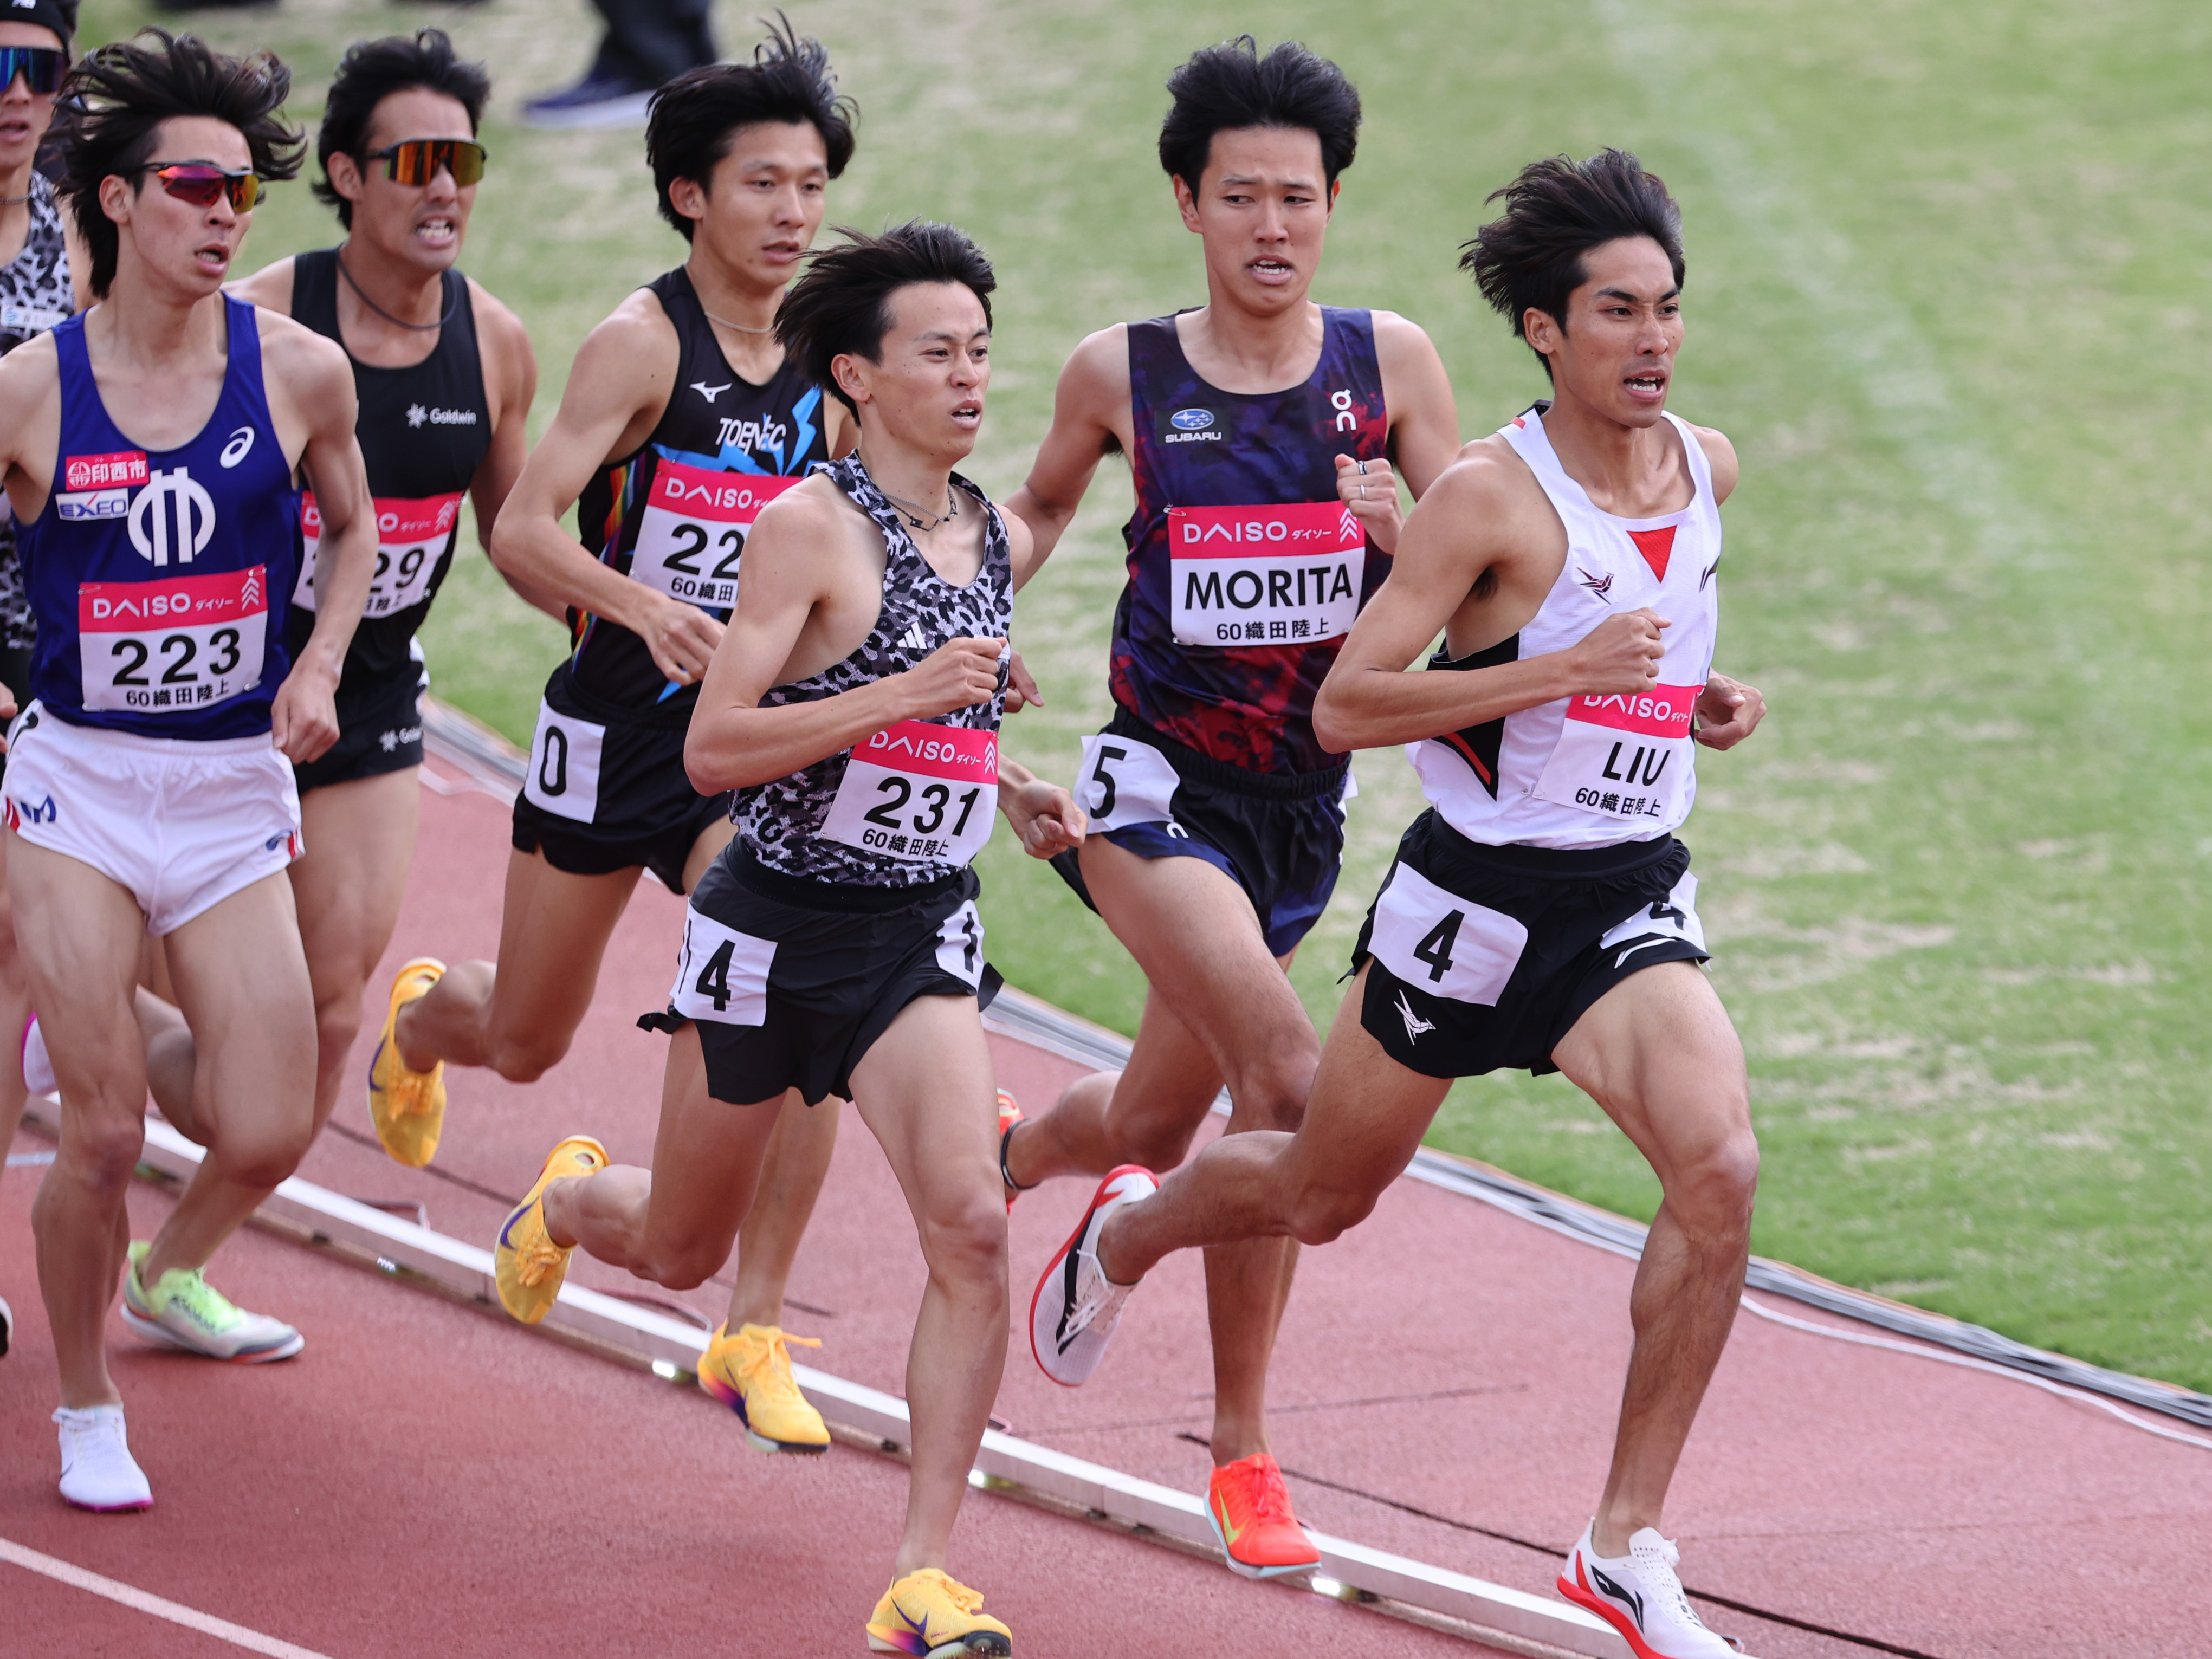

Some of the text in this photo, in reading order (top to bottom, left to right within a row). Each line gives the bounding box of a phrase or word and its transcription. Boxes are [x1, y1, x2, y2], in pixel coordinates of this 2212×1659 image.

[430, 407, 476, 425] Goldwin
[715, 414, 787, 457] TOENEC
[1165, 432, 1221, 443] SUBARU
[91, 459, 146, 484] 印西市
[59, 492, 126, 517] EXEO
[664, 477, 753, 509] DAISO
[1183, 521, 1332, 543] DAISO ダイソー
[663, 523, 745, 579] 22
[306, 549, 424, 592] 29
[671, 576, 738, 601] 60織田
[1185, 563, 1353, 610] MORITA
[93, 592, 234, 619] DAISO ダイソー
[1217, 617, 1329, 640] 60織田陸上
[111, 628, 241, 686] 223
[126, 679, 229, 707] 60織田陸上
[869, 730, 981, 766] DAISO ダイソー
[1601, 741, 1671, 786] LIU
[1090, 745, 1127, 819] 5
[863, 776, 980, 837] 231
[1575, 787, 1661, 817] 60織田陸上
[862, 828, 950, 856] 60織田陸上
[1413, 909, 1465, 983] 4
